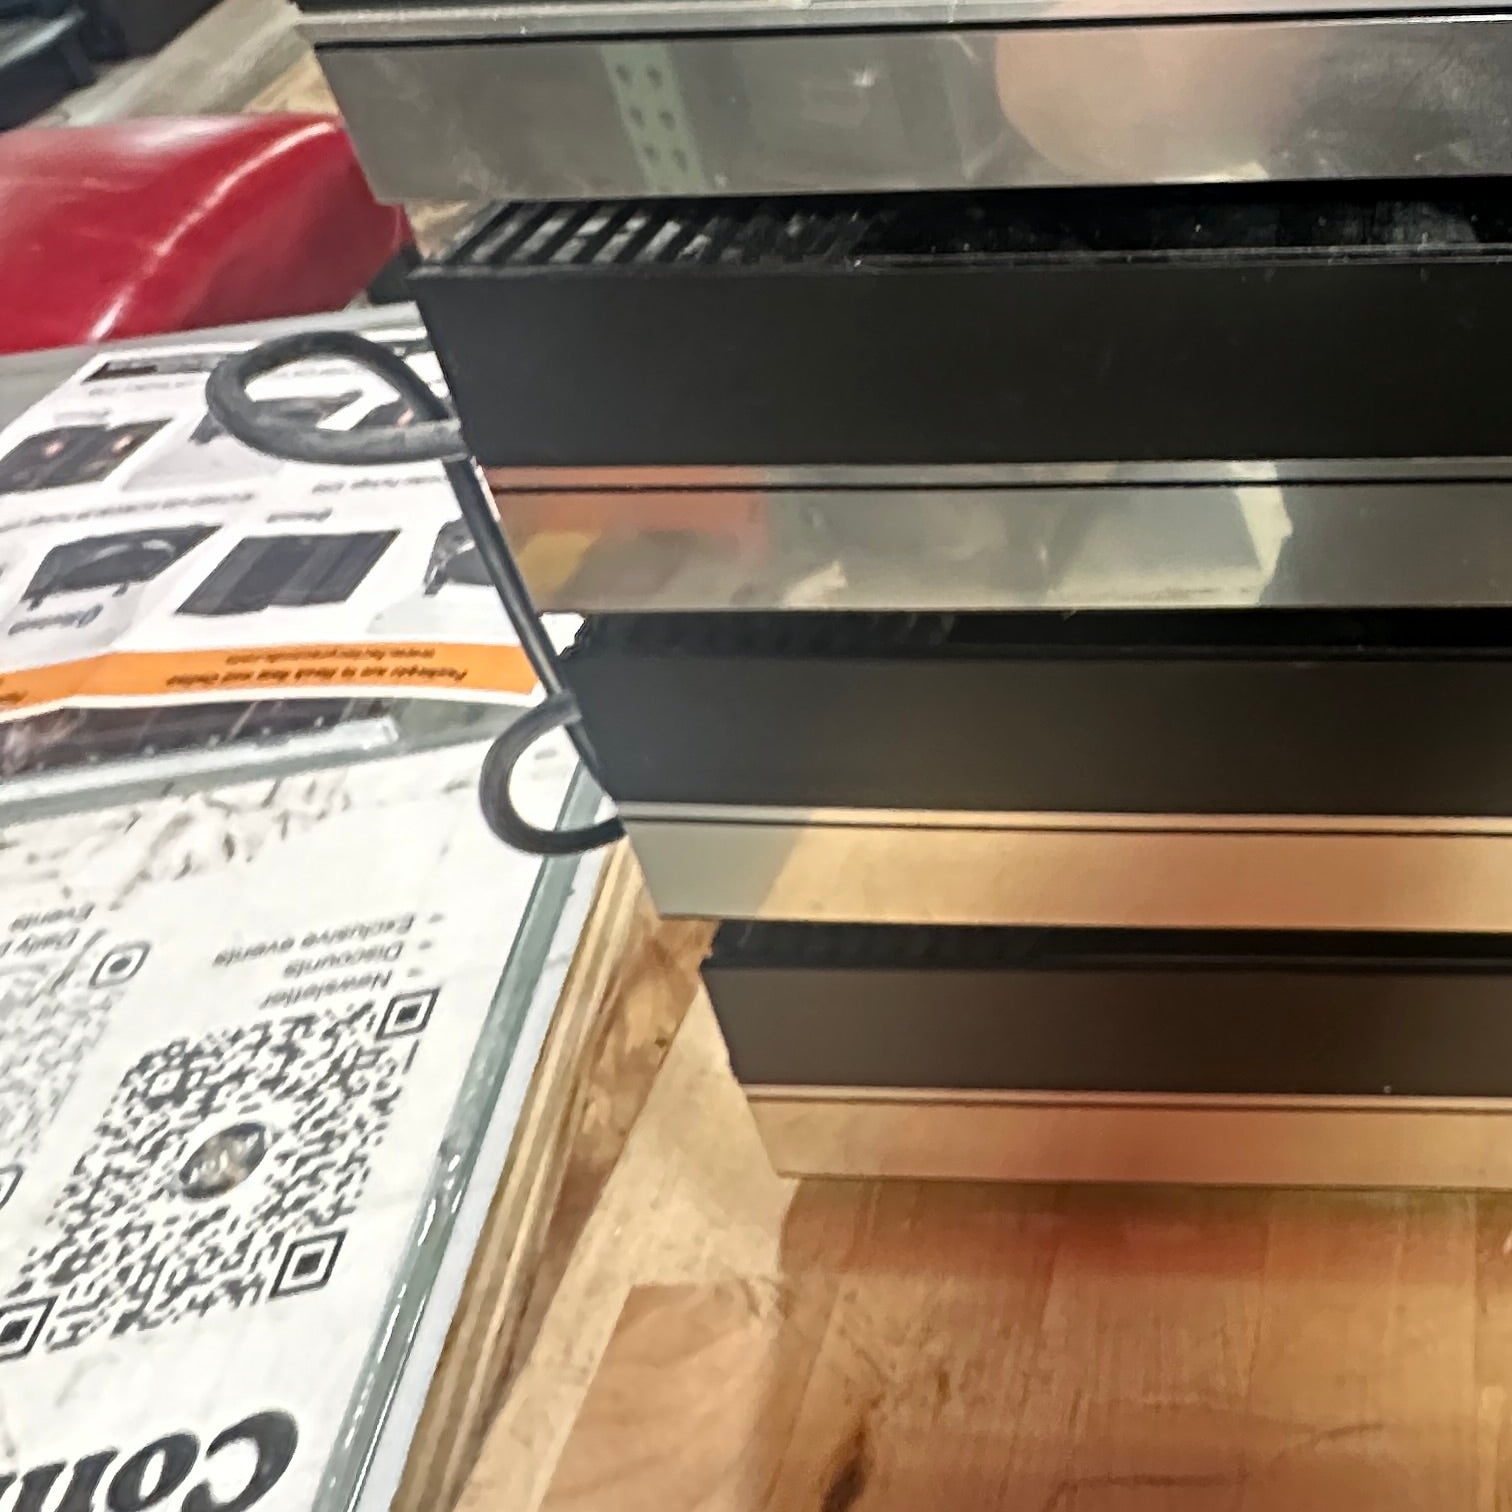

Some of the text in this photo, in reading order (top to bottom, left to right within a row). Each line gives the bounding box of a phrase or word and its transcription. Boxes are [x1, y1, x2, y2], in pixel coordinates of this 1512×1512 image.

[8, 902, 95, 932] Events
[211, 913, 415, 968] Exclusive events
[282, 941, 404, 979] Discounts
[258, 970, 393, 1010] Newsletter
